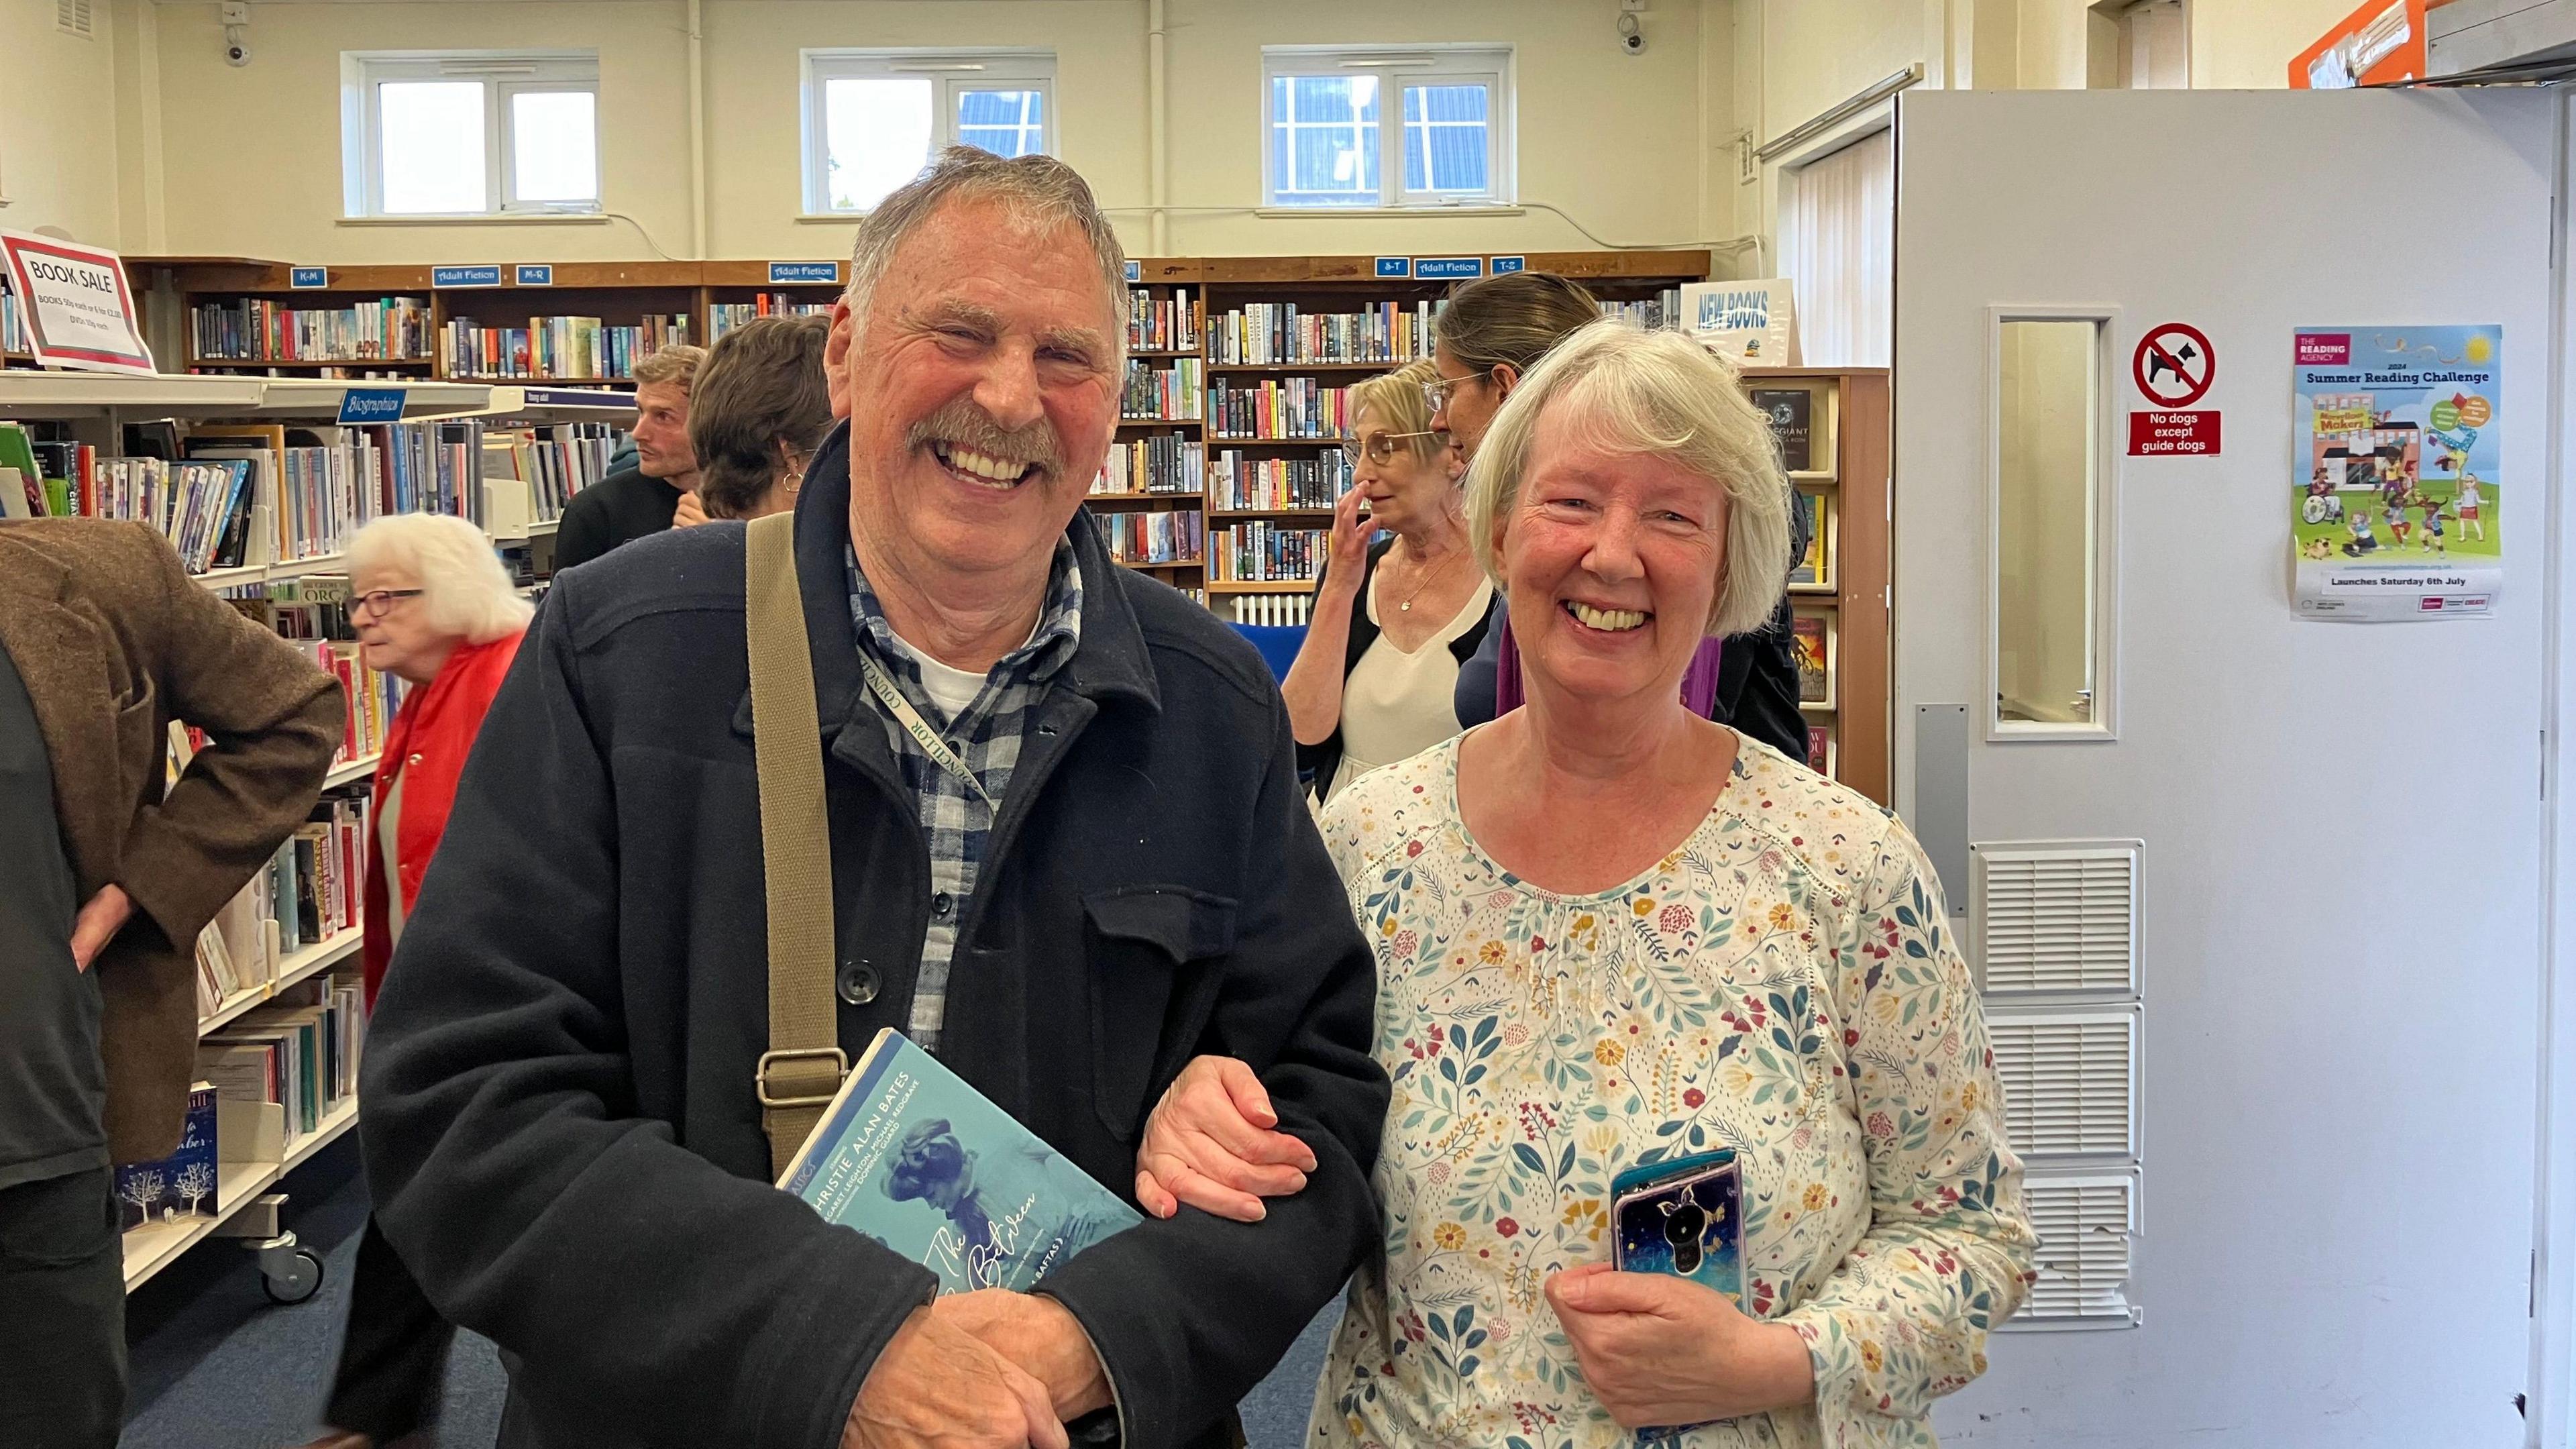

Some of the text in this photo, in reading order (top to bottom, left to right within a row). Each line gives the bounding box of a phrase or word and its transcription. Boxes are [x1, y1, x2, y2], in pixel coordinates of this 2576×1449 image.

[774, 266, 832, 276] Adult Fiction
[1385, 262, 1401, 270] S-T
[1419, 262, 1477, 273] Adult Fiction
[1499, 261, 1515, 270] T-Z
[30, 261, 113, 293] BOOK SALE
[300, 272, 317, 281] K-M
[438, 270, 494, 282] Adult Fiction
[525, 270, 543, 280] M-R
[38, 295, 62, 305] BOOKS
[1698, 291, 1767, 329] NEW BOOKS
[2300, 337, 2315, 345] THE
[2300, 345, 2345, 354] READING
[2300, 354, 2334, 362] AGENCY
[2307, 372, 2489, 384] Summer Reading Challenge
[347, 396, 398, 415] Biographies
[2150, 414, 2198, 426] No dogs
[2155, 427, 2192, 439] except
[2142, 441, 2206, 453] guide dogs
[2332, 578, 2377, 586] Launches
[2381, 578, 2424, 586] Saturday
[2445, 578, 2466, 586] July
[813, 1071, 909, 1212] HRISTIE ALAN BATES
[824, 1079, 920, 1223] RGARET LEIGHTON MICHAEL REDGRAVE
[857, 1150, 882, 1185] DOMINIC
[879, 1122, 900, 1149] GUARD
[792, 1160, 816, 1196] ASSICS
[967, 1193, 1035, 1291] Between
[923, 1226, 966, 1277] The
[1035, 1243, 1059, 1279] BAFTAS
